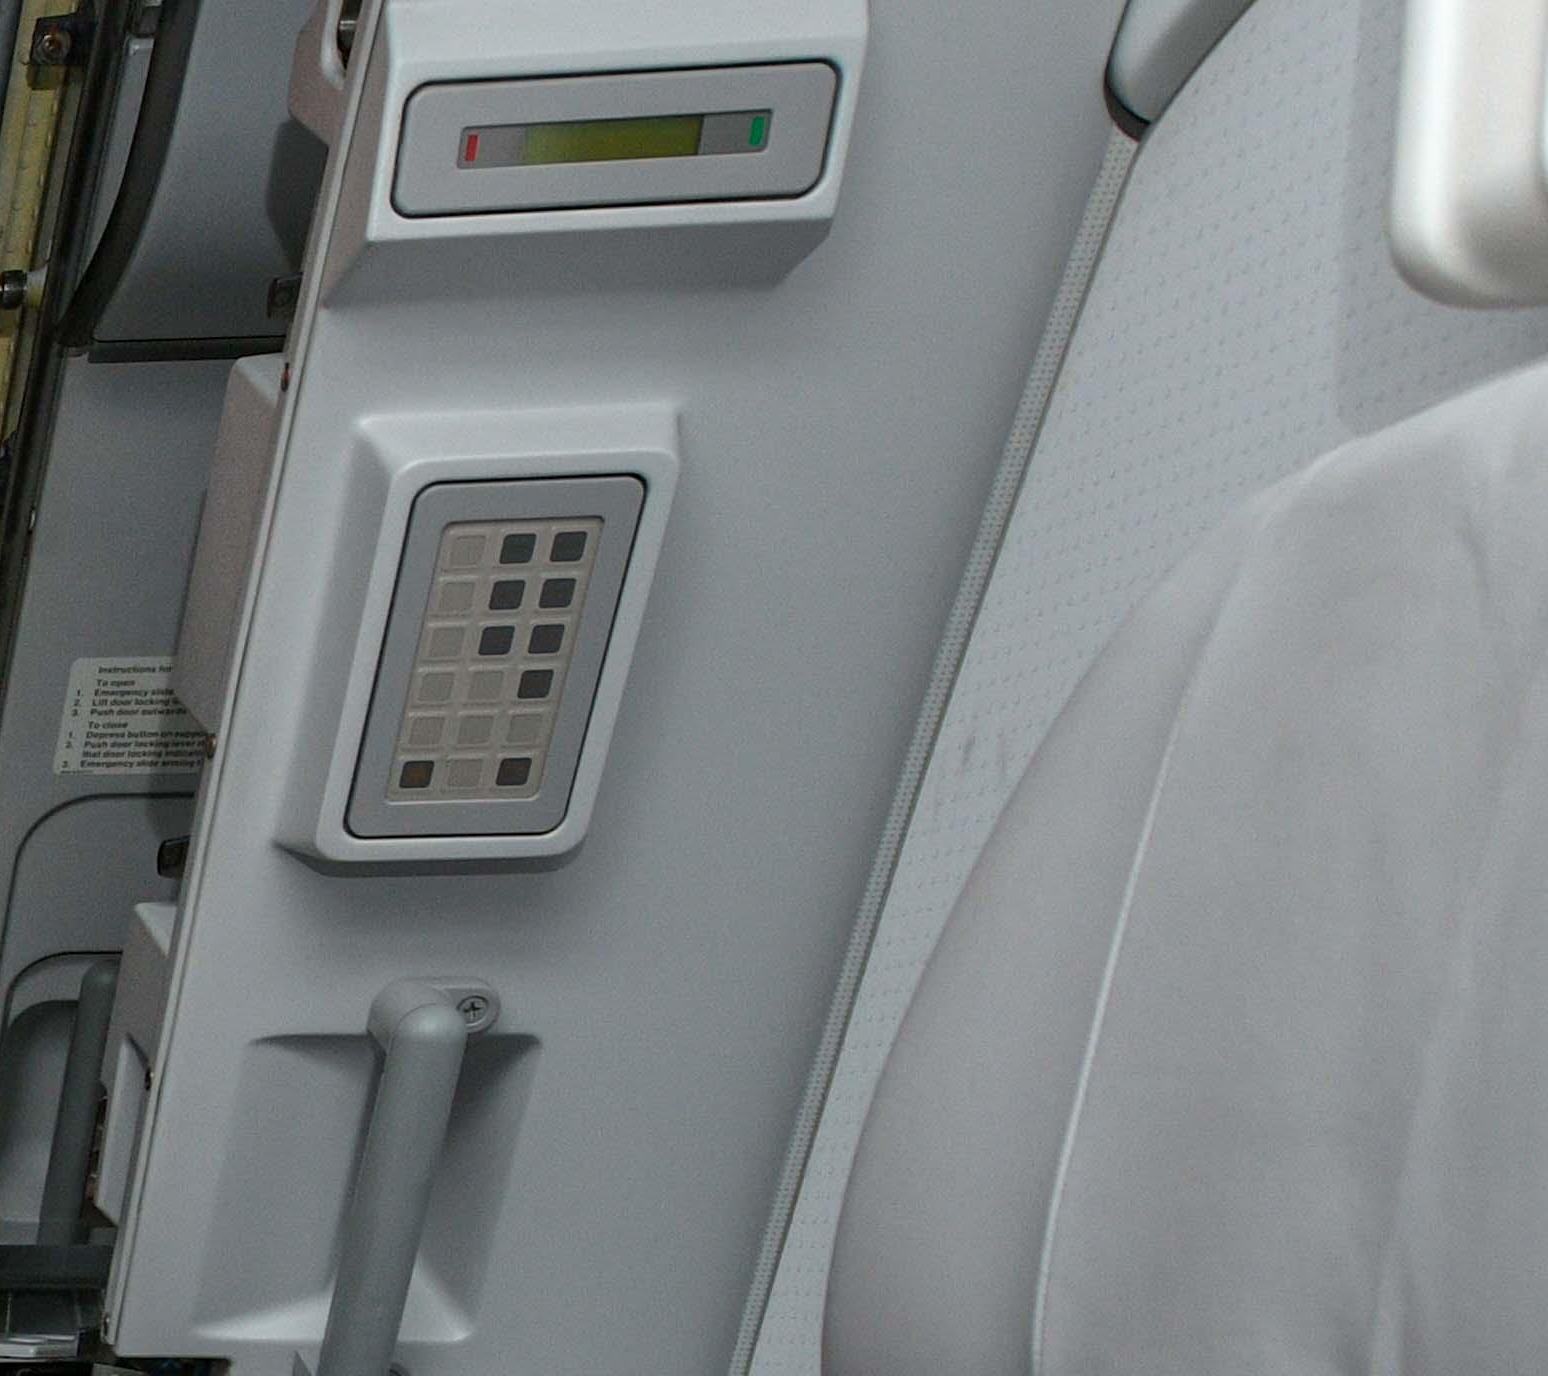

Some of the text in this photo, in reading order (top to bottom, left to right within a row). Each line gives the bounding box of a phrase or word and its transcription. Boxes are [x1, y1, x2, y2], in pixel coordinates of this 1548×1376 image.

[96, 679, 135, 688] To open
[94, 689, 148, 697] Emergency
[110, 698, 132, 706] door
[134, 698, 170, 707] locking
[90, 708, 115, 716] Push
[116, 708, 139, 716] door
[88, 721, 129, 729] To close
[86, 731, 125, 739] Depress
[84, 740, 108, 748] Push
[134, 740, 170, 749] locking
[127, 750, 162, 759] locking
[80, 760, 133, 768] Emergency
